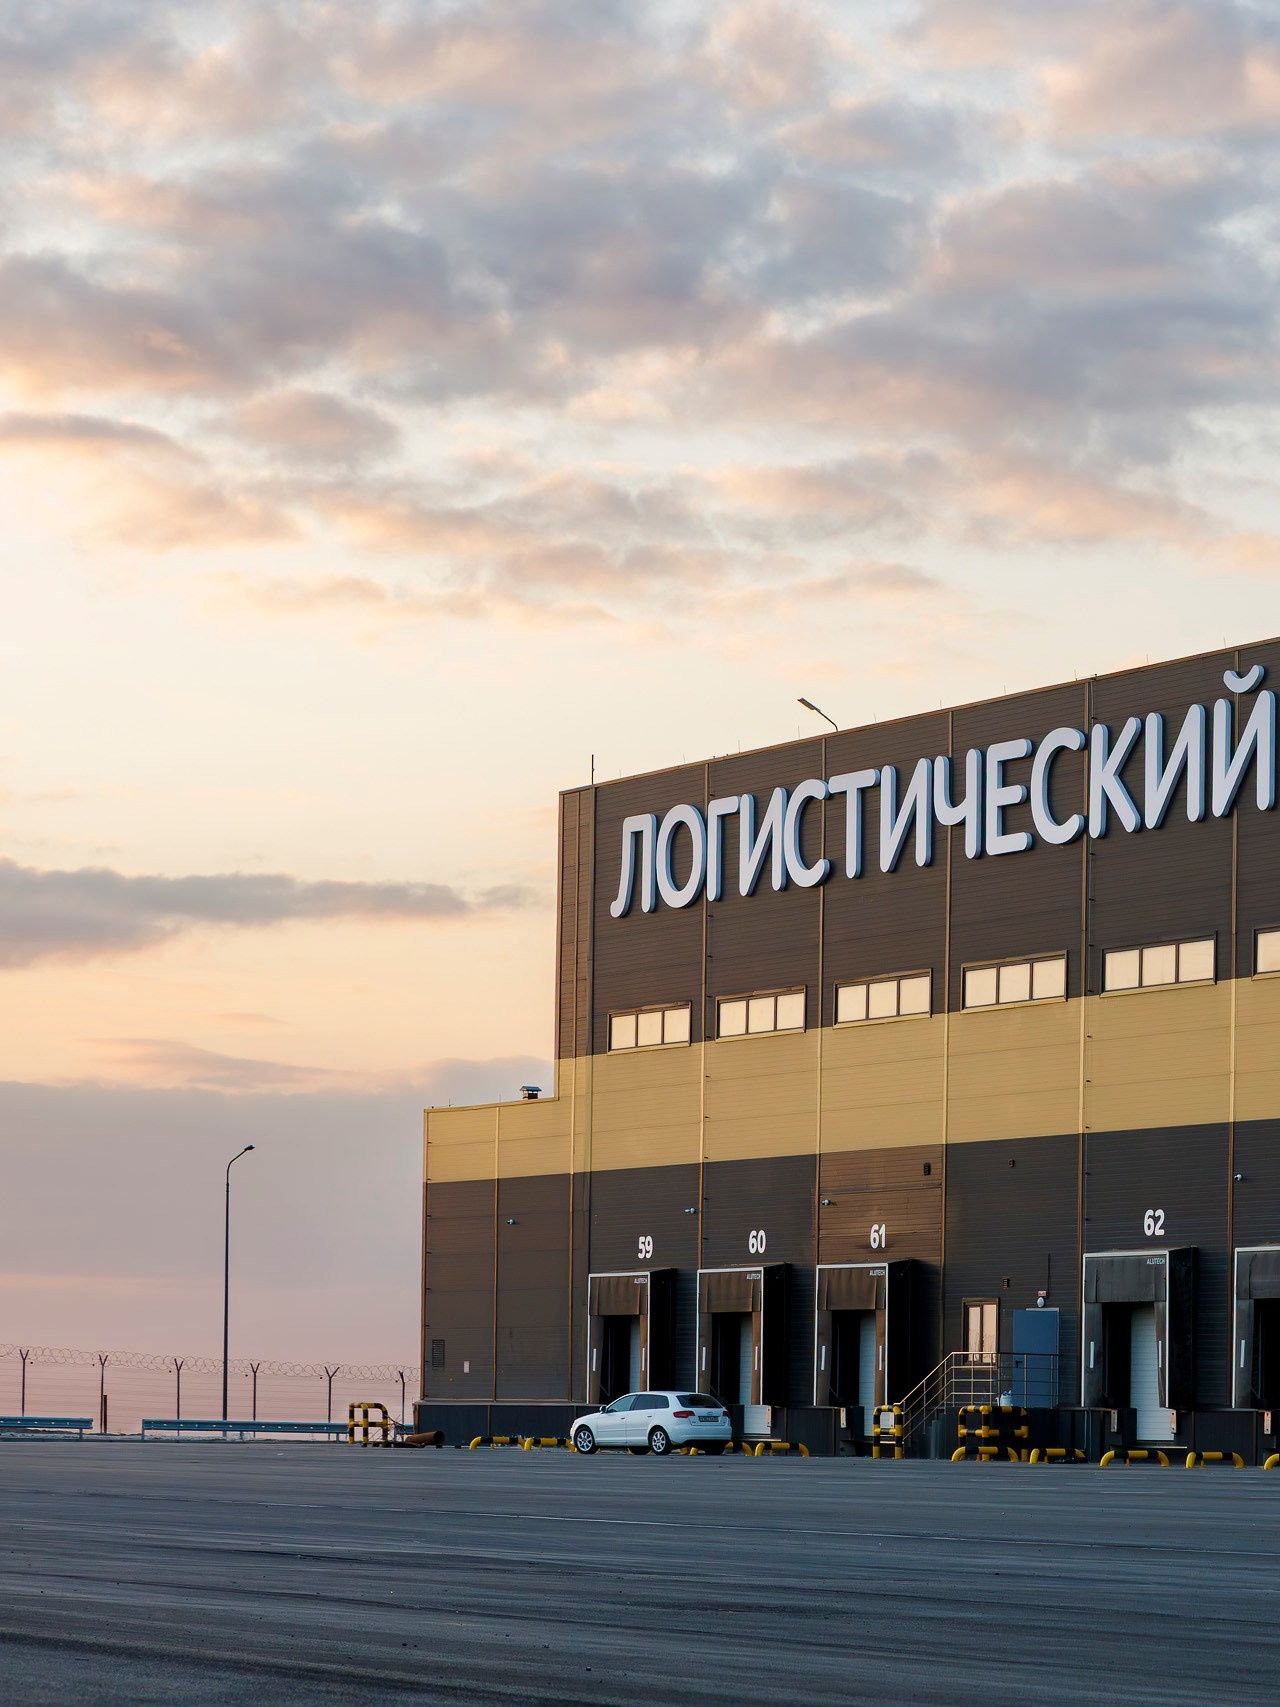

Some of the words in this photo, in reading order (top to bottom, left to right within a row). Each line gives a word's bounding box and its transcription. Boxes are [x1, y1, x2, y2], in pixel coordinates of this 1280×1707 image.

[610, 664, 1276, 919] ЛОГИСТИЧЕСКИЙ
[1144, 1209, 1165, 1236] 62
[638, 1236, 653, 1258] 59
[749, 1230, 766, 1254] 60
[870, 1224, 886, 1248] 61
